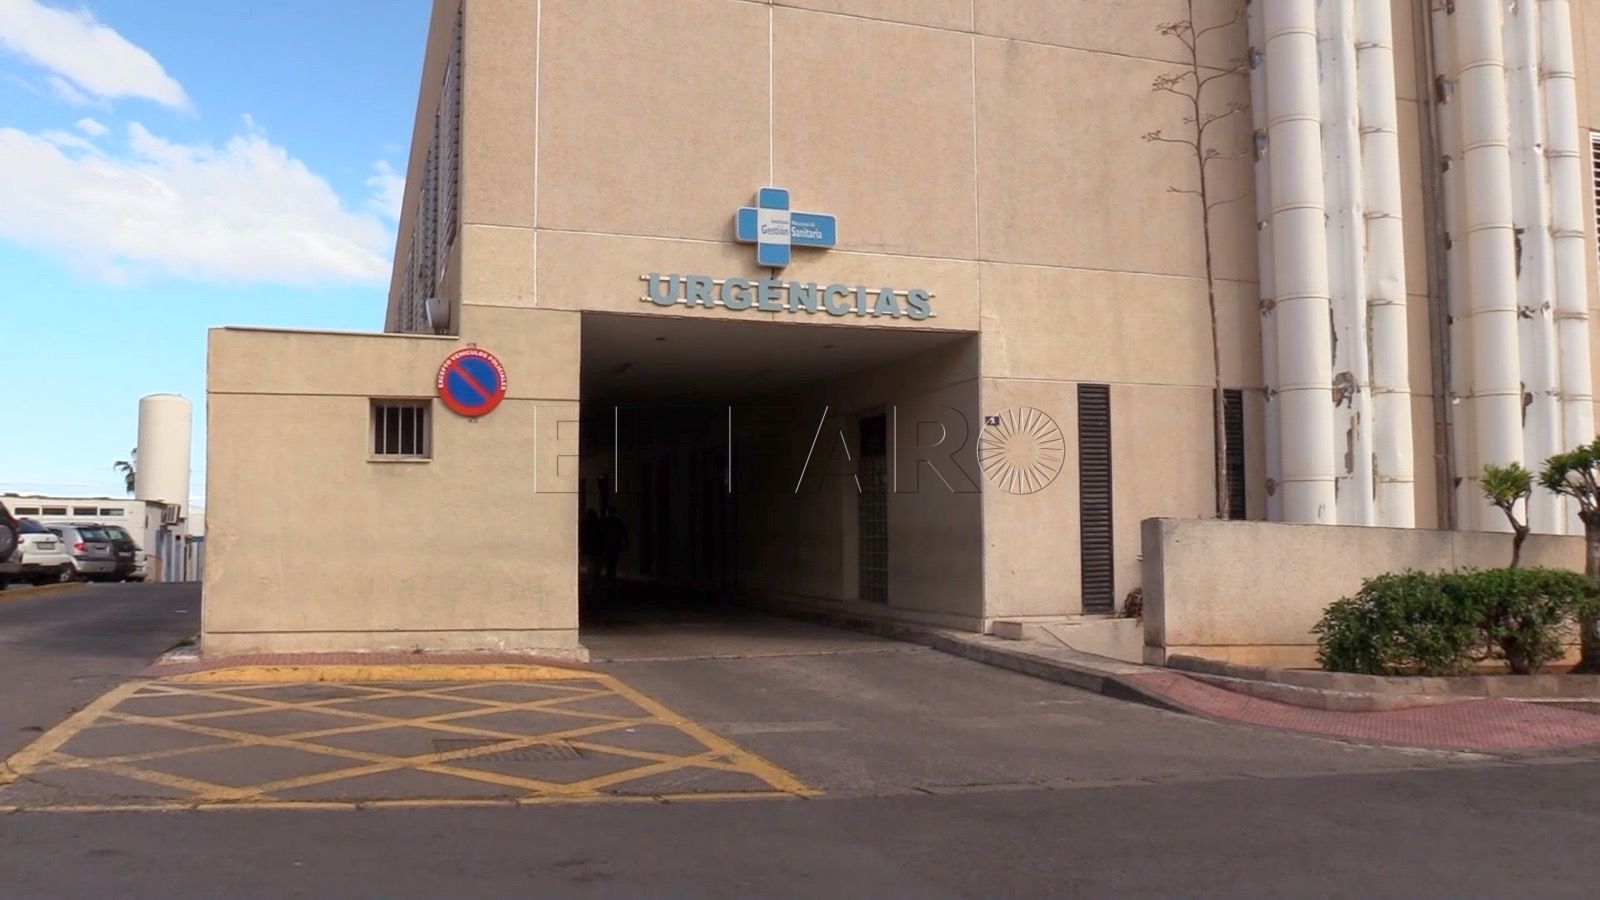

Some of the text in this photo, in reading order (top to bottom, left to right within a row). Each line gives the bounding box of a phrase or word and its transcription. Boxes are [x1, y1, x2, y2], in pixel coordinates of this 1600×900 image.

[761, 224, 823, 239] Gestión Sanitaria
[649, 273, 931, 320] URGENCIAS
[438, 350, 506, 390] EXCEPTO VEHICULOS POLICIALES
